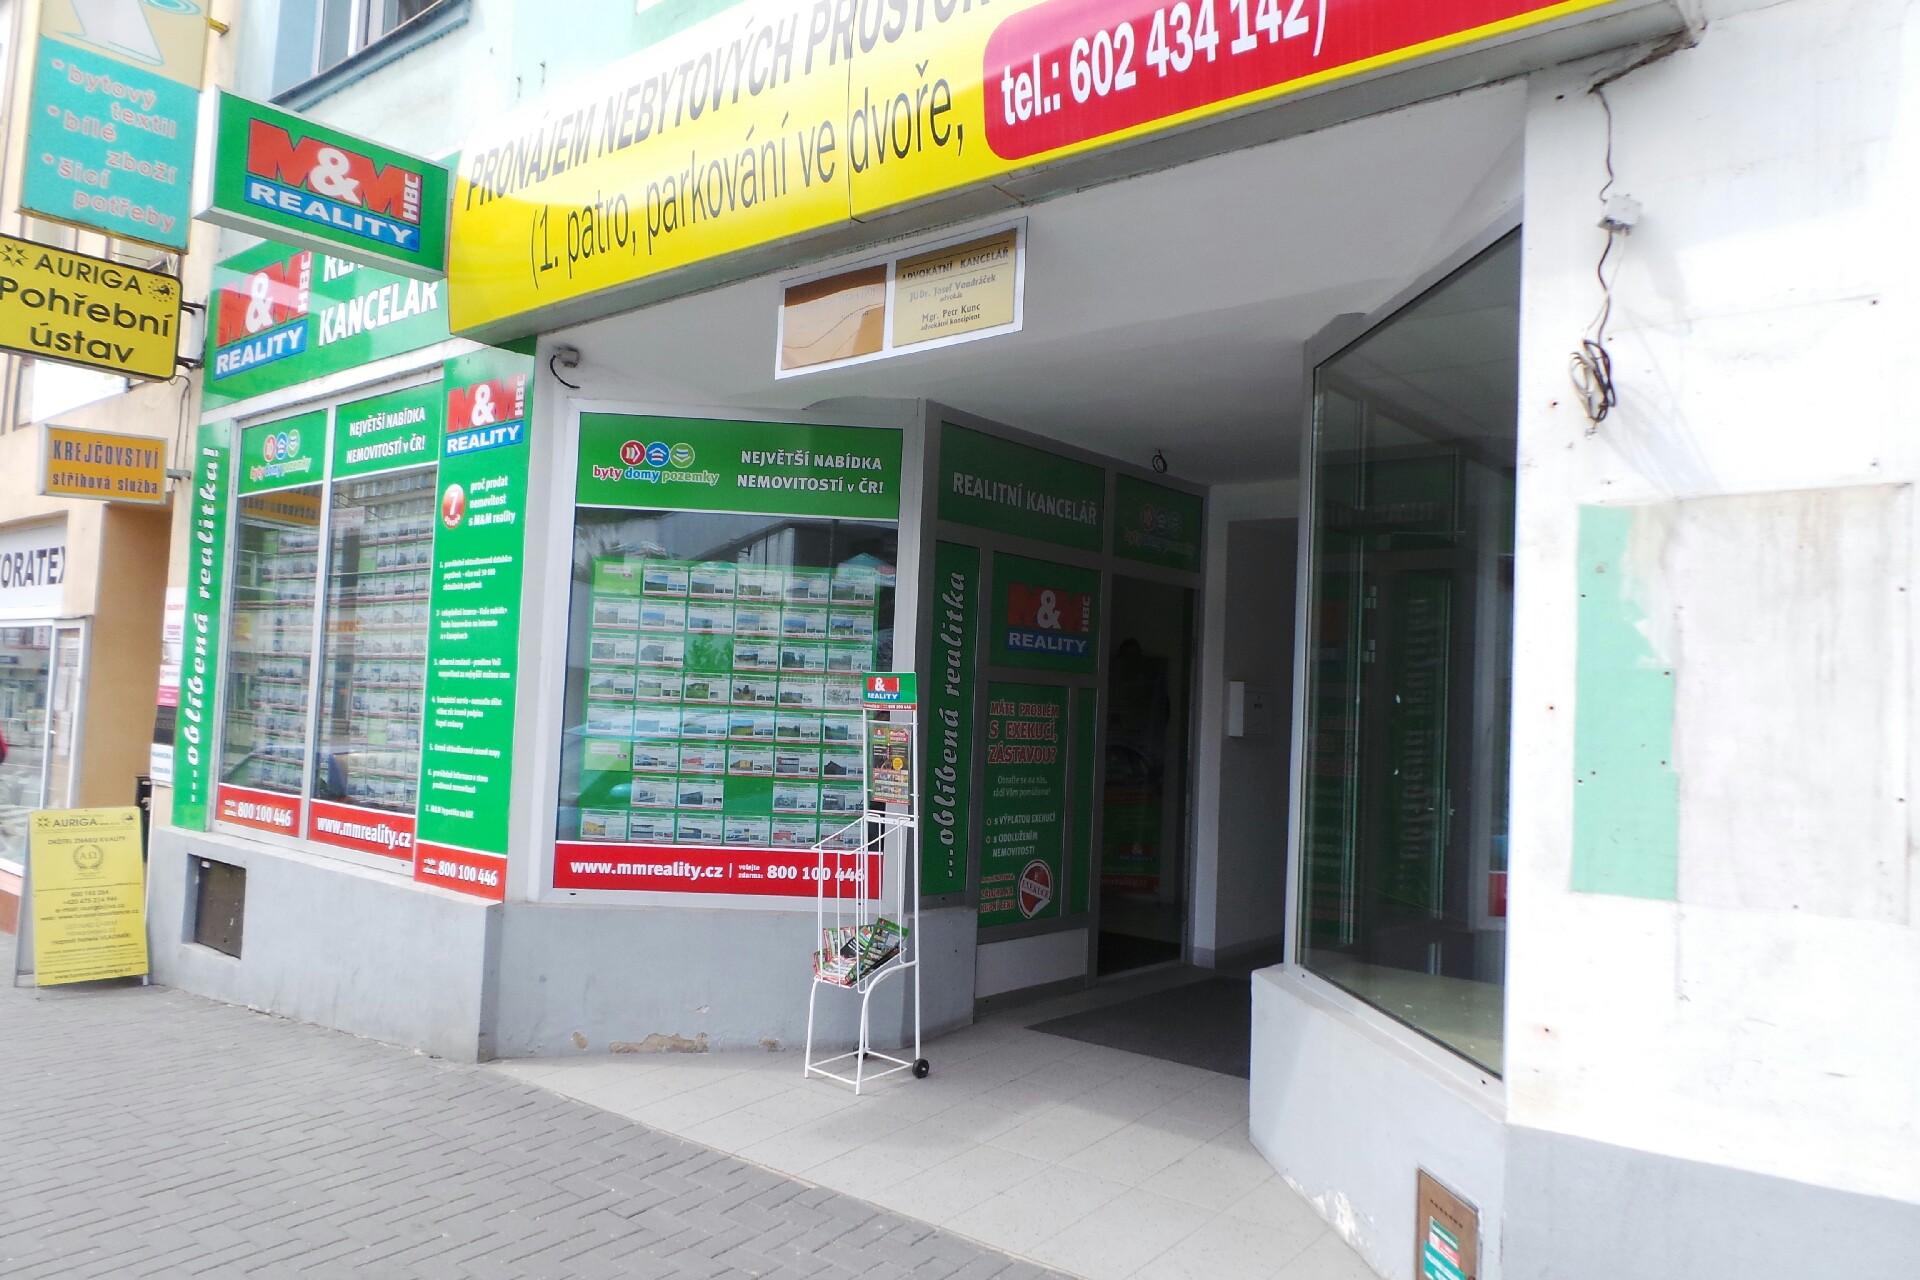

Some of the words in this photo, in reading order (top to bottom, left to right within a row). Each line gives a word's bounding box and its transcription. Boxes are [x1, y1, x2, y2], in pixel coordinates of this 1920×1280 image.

[1001, 53, 1061, 126] tel.:
[1069, 22, 1136, 104] 602
[1146, 1, 1219, 78] 434
[69, 63, 157, 110] bytový
[63, 112, 117, 143] bílé
[111, 100, 177, 139] textil
[466, 103, 595, 211] PRONÁJEM
[598, 13, 797, 158] NEBYTOVÝCH
[59, 154, 110, 190] šicí
[106, 148, 177, 184] zboží
[247, 118, 403, 219] M&M
[529, 210, 559, 290] (1.
[567, 192, 637, 279] patro,
[646, 111, 788, 256] parkování
[798, 119, 836, 187] ve
[849, 58, 964, 174] dvoře,
[73, 187, 176, 234] potřeby
[402, 173, 421, 223] HBC
[250, 182, 413, 246] REALITY
[33, 253, 143, 297] AURIGA
[901, 259, 953, 282] ADVOKÁTNÍ
[960, 246, 1009, 269] KANCELÁŘ
[933, 283, 952, 297] Josef
[955, 273, 996, 292] Vondráček
[0, 276, 174, 339] Pohřební
[922, 312, 940, 323] Mgr.
[942, 308, 959, 319] Petr
[960, 303, 981, 315] Kunc
[29, 320, 135, 364] ústav
[215, 325, 304, 376] REALITY
[447, 378, 519, 434] M&M
[515, 374, 525, 418] HBC
[349, 412, 386, 437] NEJVĚTŠÍ
[386, 406, 426, 429] NABÍDKA
[346, 436, 403, 464] NEMOVITOSTÍ
[403, 442, 409, 454] v
[409, 433, 426, 452] ČR!
[447, 424, 521, 453] REALITY
[53, 439, 160, 470] KREJČOVSTVÍ
[741, 448, 810, 468] NEJVĚTŠÍ
[813, 453, 882, 470] NABÍDKA
[117, 477, 158, 494] služba
[470, 478, 486, 494] proč
[485, 475, 509, 493] prodat
[592, 465, 622, 480] byty
[625, 468, 661, 483] domy
[661, 471, 720, 486] pozemky
[737, 474, 843, 492] NEMOVITOSTÍ
[847, 483, 855, 493] v
[857, 477, 884, 494] ČR!
[449, 490, 459, 516] 7
[469, 493, 507, 509] nemovitost
[953, 472, 1023, 508] REALITNÍ
[1026, 489, 1097, 525] KANCELÁŘ
[196, 448, 221, 600] realitka!
[474, 513, 492, 526] M&M
[492, 510, 516, 525] reality
[1007, 581, 1085, 632] M&M
[1081, 595, 1091, 633] HBC
[940, 571, 966, 698] realitka
[1008, 632, 1087, 653] REALITY
[990, 699, 1015, 716] MÁTE
[1019, 701, 1059, 718] PROBLÉM
[989, 720, 999, 739] S
[1006, 720, 1058, 743] EXEKUCÍ,
[988, 741, 1057, 763] ZÁSTAVOU?
[53, 817, 98, 828] AURIGA
[237, 802, 254, 821] 800
[255, 804, 272, 823] 100
[273, 807, 291, 828] 446
[999, 812, 1031, 825] VÝPLATOU
[316, 815, 412, 850] www.mmreality.cz
[993, 846, 1035, 858] NEMOVITOSTI
[438, 860, 456, 879] 800
[458, 863, 476, 882] 100
[478, 866, 498, 888] 446
[570, 860, 724, 881] www.mmreality.cz
[766, 864, 797, 880] 800
[802, 866, 831, 881] 100
